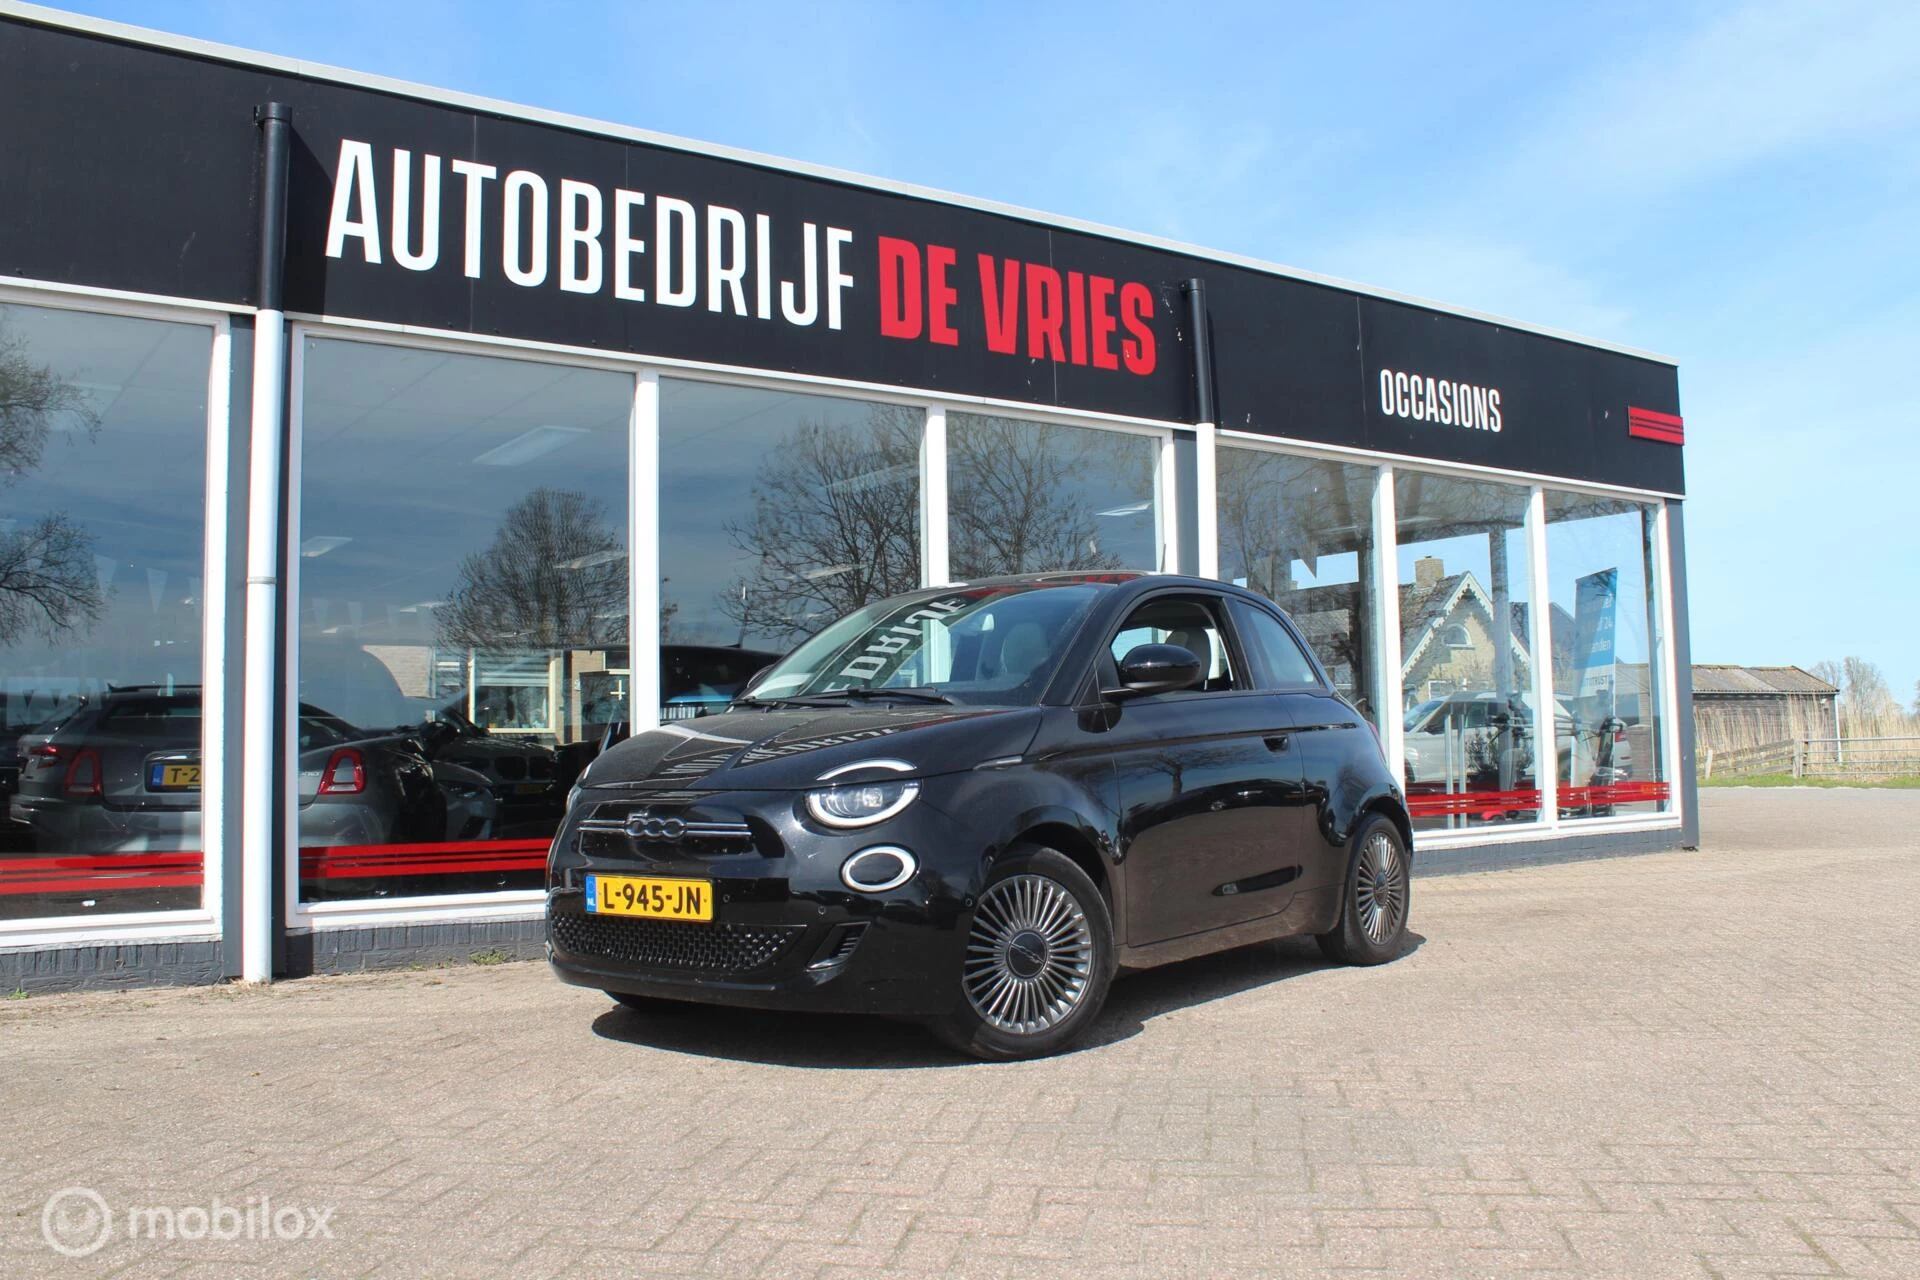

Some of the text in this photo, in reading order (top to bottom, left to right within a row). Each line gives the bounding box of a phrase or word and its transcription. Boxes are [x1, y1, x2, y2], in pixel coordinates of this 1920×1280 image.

[325, 139, 1157, 376] AUTOBEDRIJF DE VRIES
[1380, 369, 1502, 433] OCCASIONS
[625, 811, 686, 838] 500
[603, 882, 701, 915] L-945-JN
